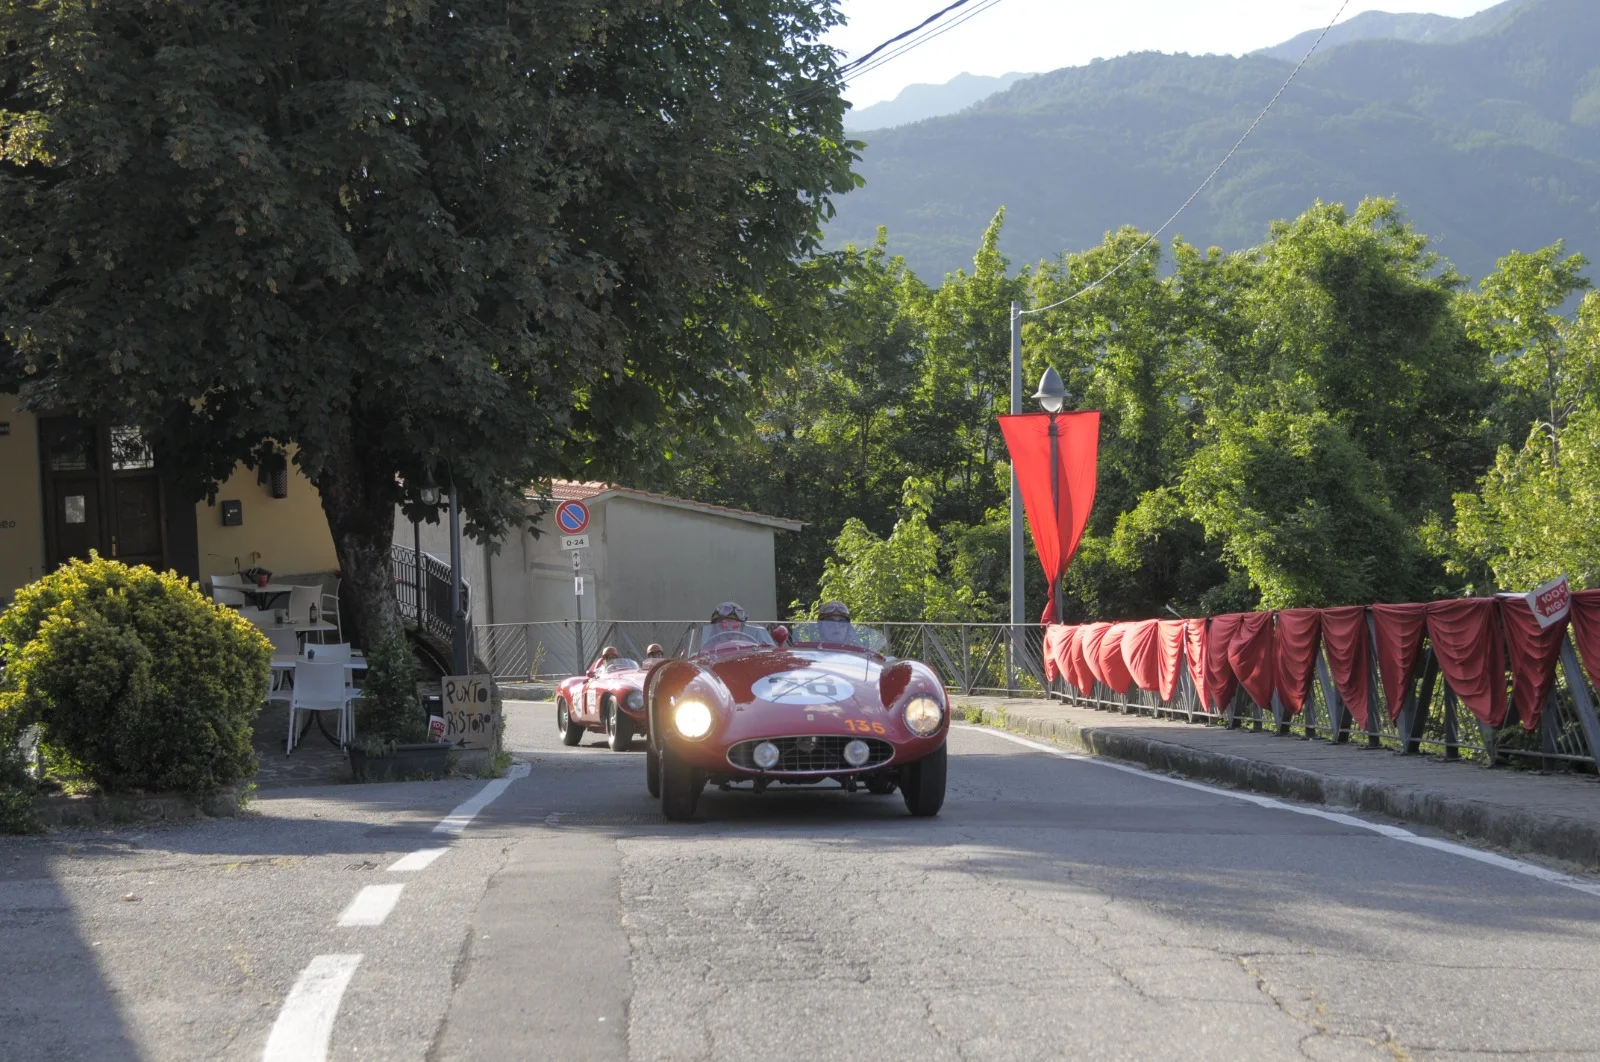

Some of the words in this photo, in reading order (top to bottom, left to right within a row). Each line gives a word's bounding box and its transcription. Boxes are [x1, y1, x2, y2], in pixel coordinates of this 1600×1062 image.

[566, 539, 584, 547] 0-24
[1545, 594, 1567, 615] MIGL
[445, 679, 488, 704] PUNTO
[844, 719, 886, 735] 135
